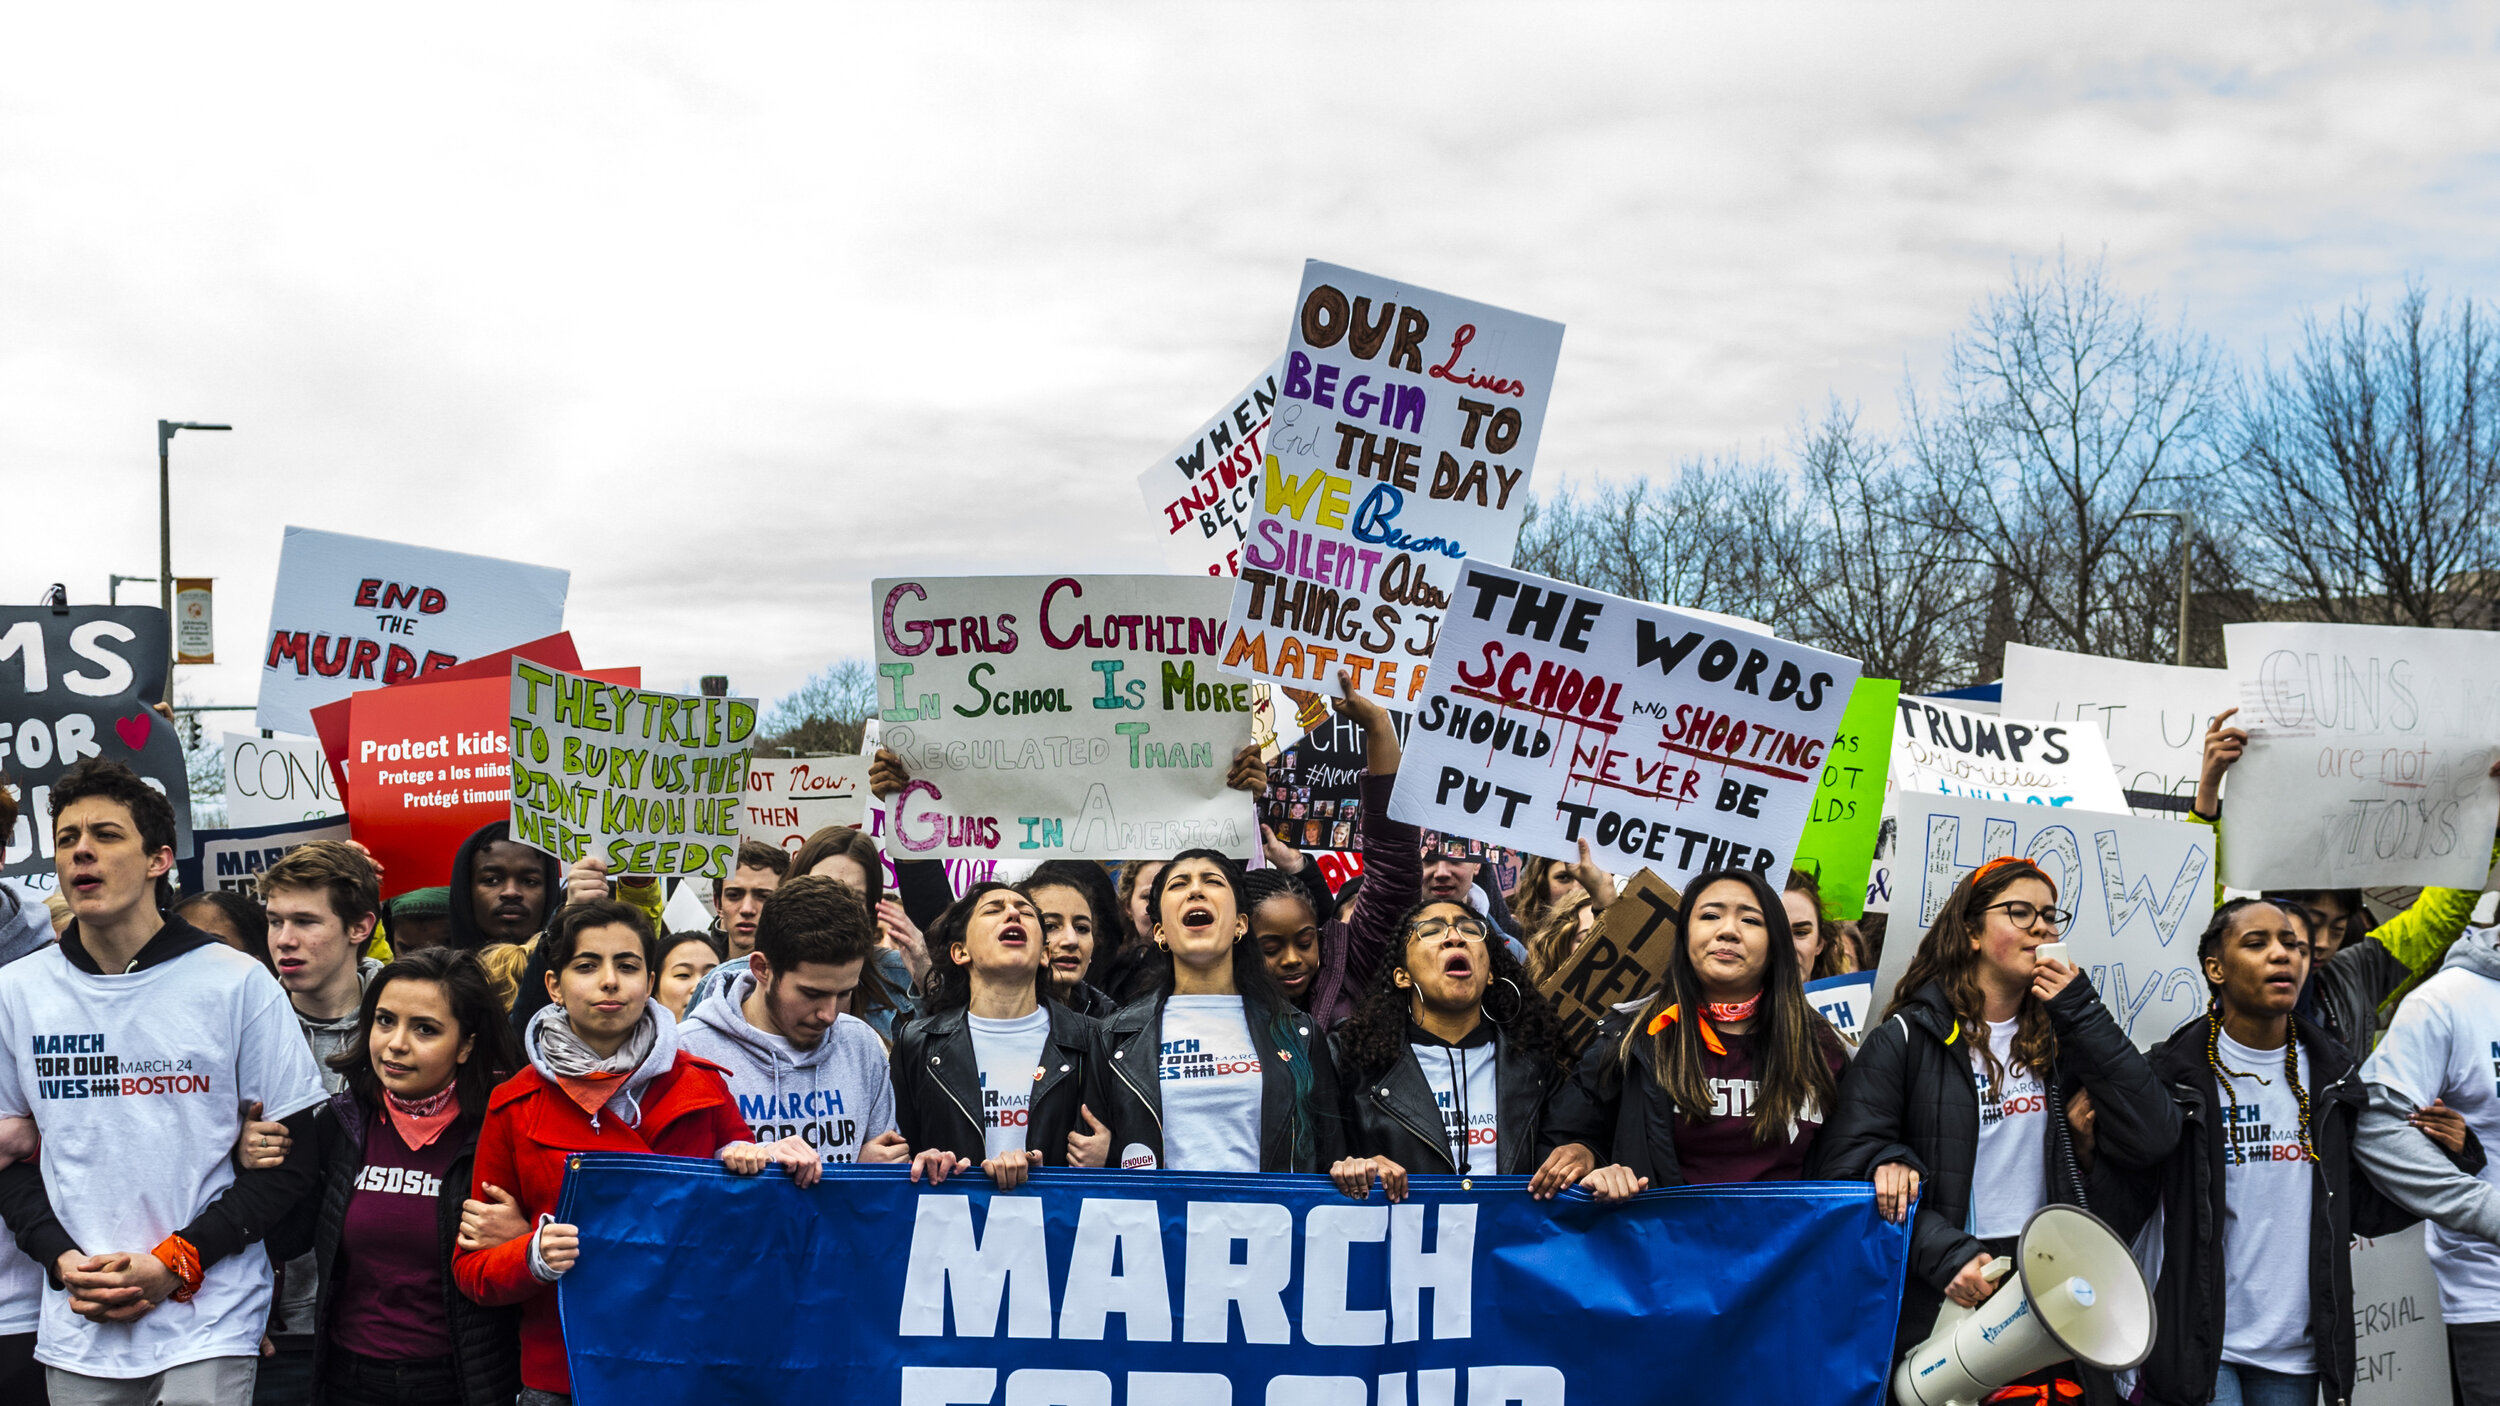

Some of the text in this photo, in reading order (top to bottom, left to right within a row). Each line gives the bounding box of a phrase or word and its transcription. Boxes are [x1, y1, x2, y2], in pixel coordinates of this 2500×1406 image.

[1300, 283, 1525, 398] OUR Lives
[1174, 375, 1278, 480] WHEN
[1283, 350, 1524, 456] BEGIN TO
[1272, 404, 1524, 511] End THE DAY
[1264, 454, 1468, 560] WE Become
[1246, 518, 1383, 595] SILENT
[354, 578, 448, 614] END
[376, 615, 419, 636] THE
[1238, 566, 1402, 657] THINGS
[1466, 570, 1834, 712] THE WORDS
[517, 663, 757, 749] THEY TRIED
[1458, 640, 1826, 770] SCHOOL AND SHOOTING
[2260, 649, 2420, 732] GUNS
[360, 735, 450, 764] Protect
[510, 716, 754, 795] TO BURY US, THEY
[1418, 695, 1552, 759] SHOULD
[1570, 743, 1701, 799] NEVER
[1714, 778, 1769, 820] BE
[1898, 698, 2070, 765] TRUMP'S
[2318, 741, 2433, 782] are not
[378, 769, 434, 786] Protege
[438, 769, 447, 781] a
[450, 765, 472, 780] los
[404, 789, 460, 809] Protégé
[512, 758, 740, 836] DIDN'T KNOW WE
[747, 772, 775, 792] OT
[1807, 798, 1857, 823] LDS
[513, 803, 592, 865] WERE
[606, 838, 734, 880] SEEDS
[746, 806, 799, 828] THEN
[1018, 816, 1064, 850] IN
[1436, 766, 1533, 829] PUT
[1556, 800, 1776, 881] TOGETHER
[2348, 798, 2460, 860] TOYS
[1919, 814, 2208, 948] HOW
[32, 1034, 105, 1055] MARCH
[34, 1056, 120, 1078] FOR OUR
[120, 1060, 193, 1074] MARCH 24
[121, 1075, 210, 1096] BOSTON
[739, 1090, 845, 1120] MARCH
[802, 1120, 856, 1150] OUR
[898, 1193, 1479, 1347] MARCH
